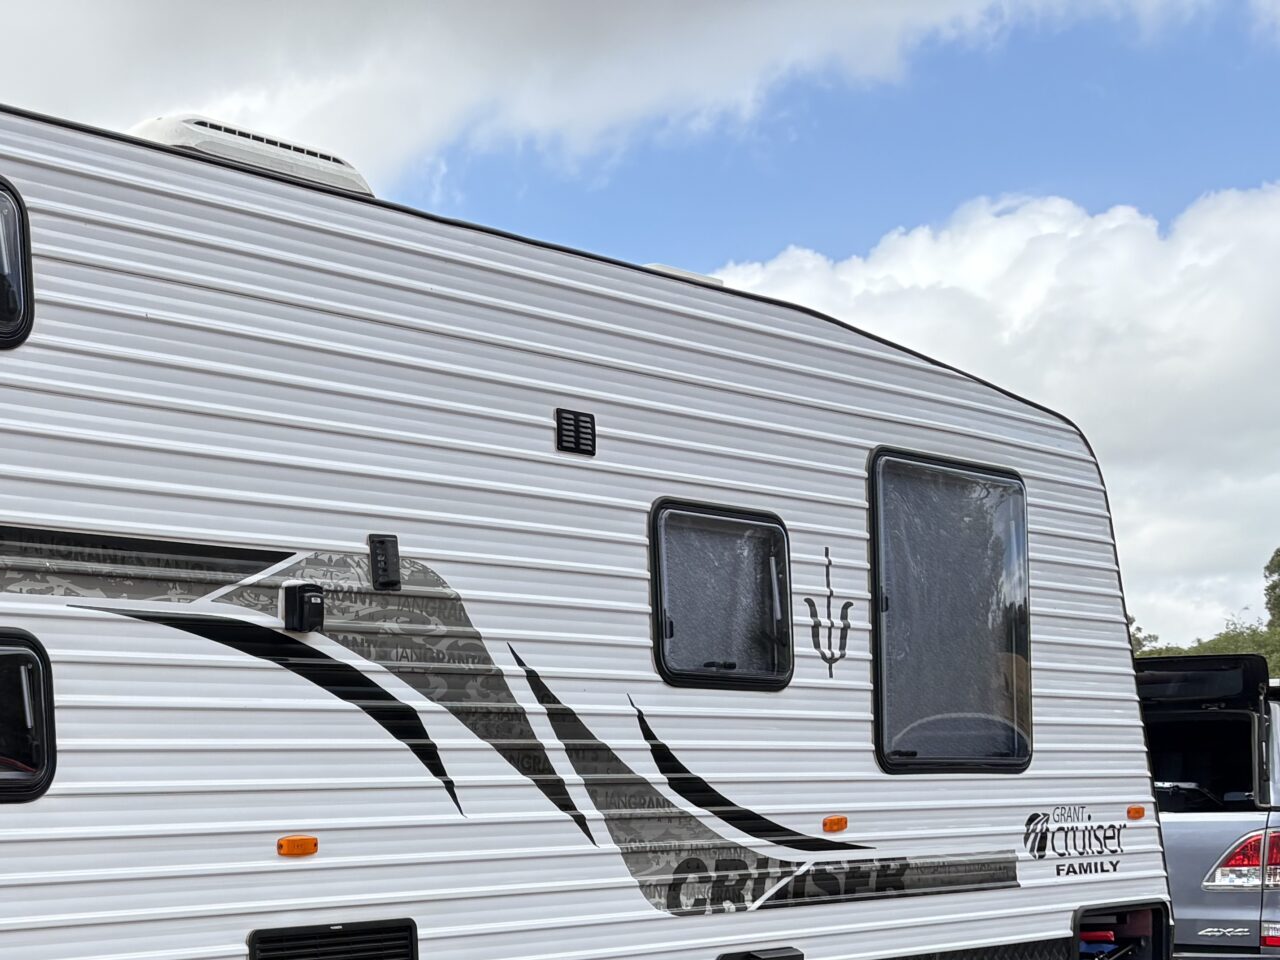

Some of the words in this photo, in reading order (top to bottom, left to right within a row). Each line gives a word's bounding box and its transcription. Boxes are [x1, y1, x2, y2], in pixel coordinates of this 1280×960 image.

[1052, 805, 1086, 823] GRANT
[1051, 814, 1127, 857] cruiser
[1056, 860, 1120, 877] FAMILY
[666, 856, 909, 916] CRUISER
